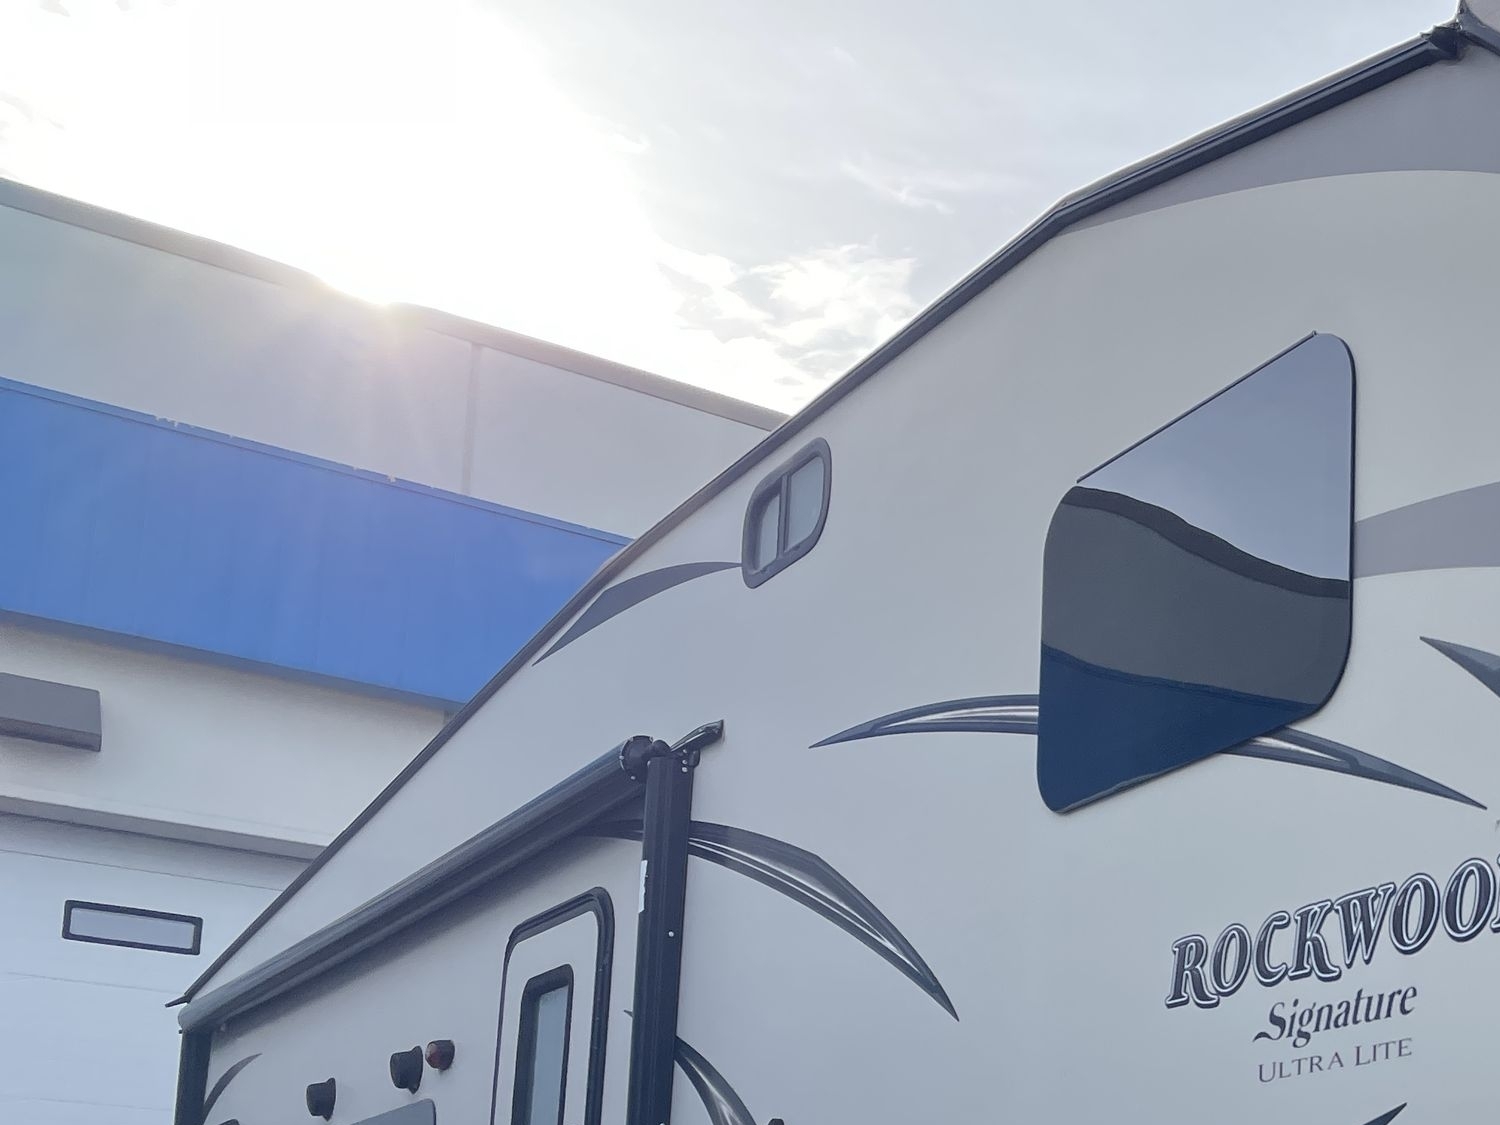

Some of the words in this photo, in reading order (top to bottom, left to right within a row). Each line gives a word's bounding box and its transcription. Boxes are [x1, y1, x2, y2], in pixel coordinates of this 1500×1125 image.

[1252, 985, 1418, 1049] Signature
[1258, 1051, 1345, 1083] ULTRA
[1354, 1037, 1413, 1067] LITE
